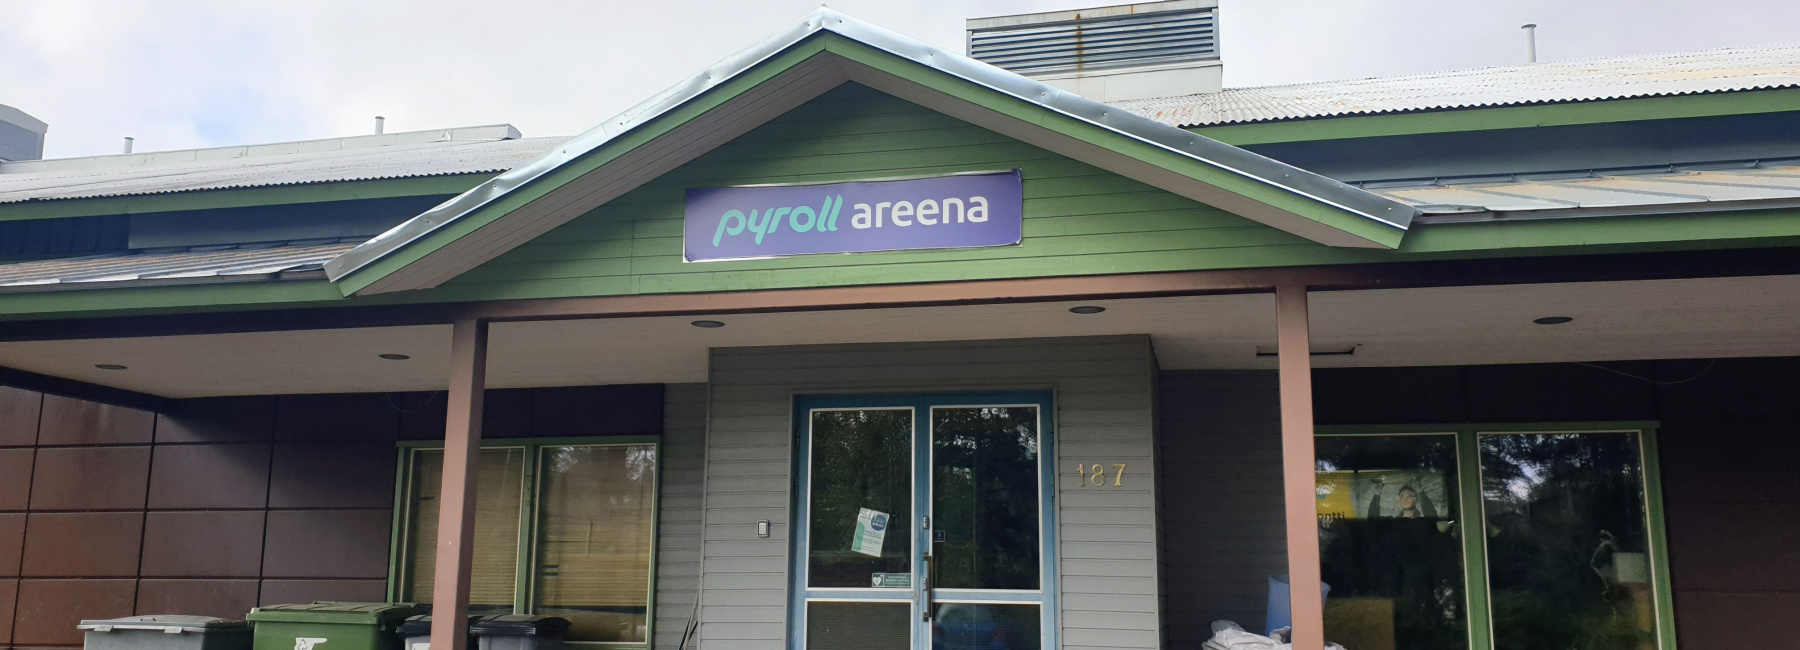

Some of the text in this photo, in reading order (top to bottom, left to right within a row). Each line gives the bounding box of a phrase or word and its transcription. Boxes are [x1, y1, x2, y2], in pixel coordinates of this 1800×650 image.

[712, 194, 989, 247] pyroll areena
[1076, 463, 1126, 487] 187
